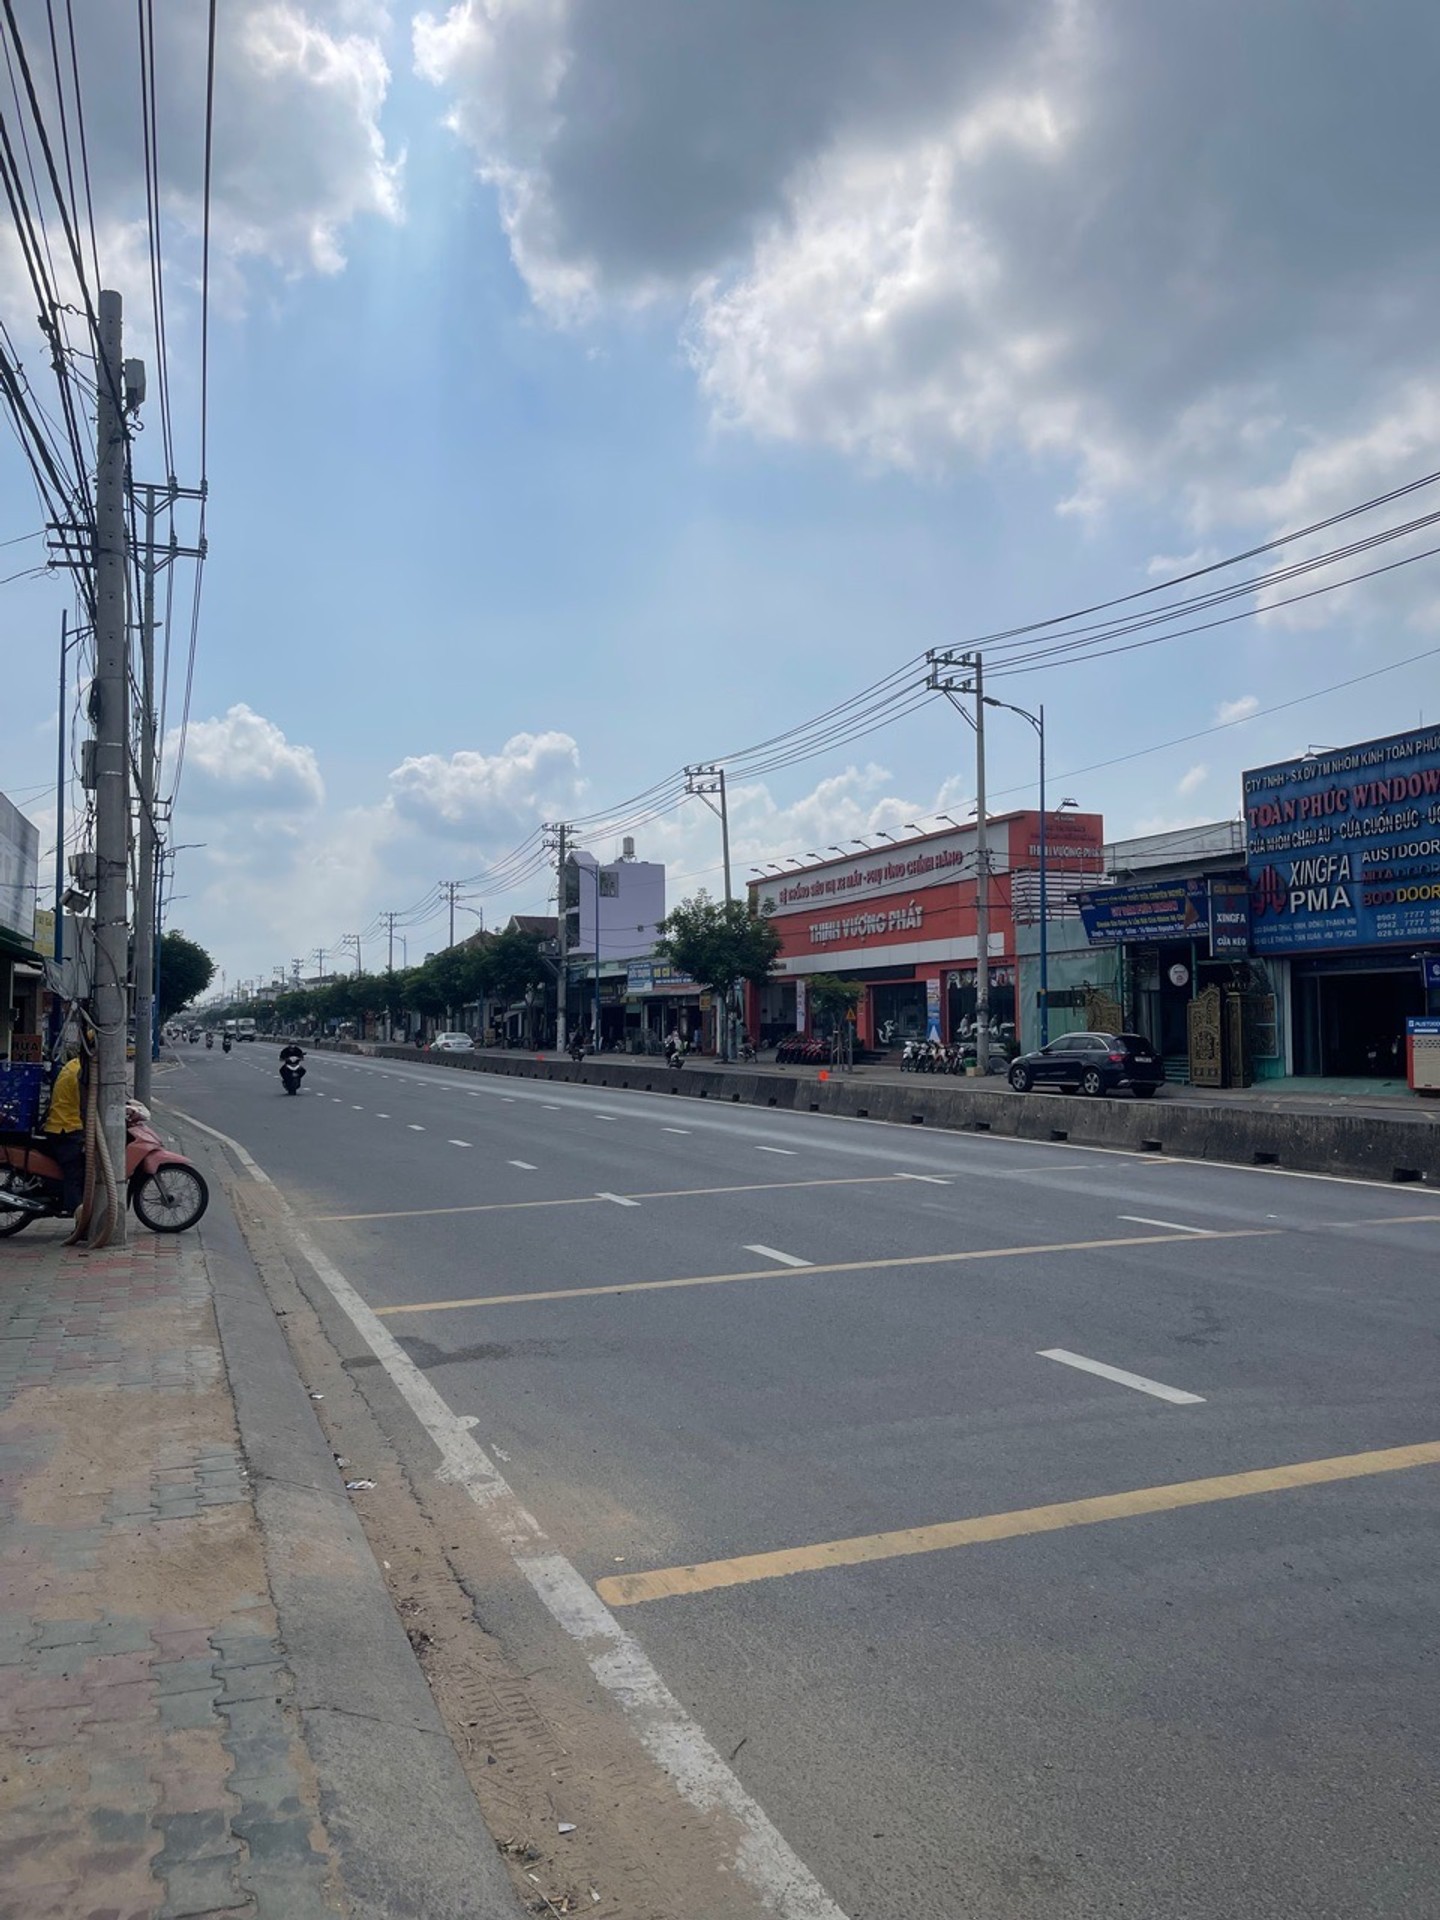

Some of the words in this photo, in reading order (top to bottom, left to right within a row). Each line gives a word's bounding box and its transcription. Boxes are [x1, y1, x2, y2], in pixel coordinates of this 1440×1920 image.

[1244, 778, 1262, 793] CTY
[1263, 774, 1285, 789] TNHH
[1386, 739, 1413, 760] TOÀN
[1248, 796, 1300, 829] TOÀN
[1300, 784, 1349, 820] PHÚC
[1289, 854, 1351, 888] XINGFA
[1216, 913, 1246, 923] XINGFA
[1290, 886, 1351, 914] PMA
[809, 921, 841, 947] THỊNH
[842, 910, 886, 942] VƯỢNG
[888, 899, 924, 932] PHÁT
